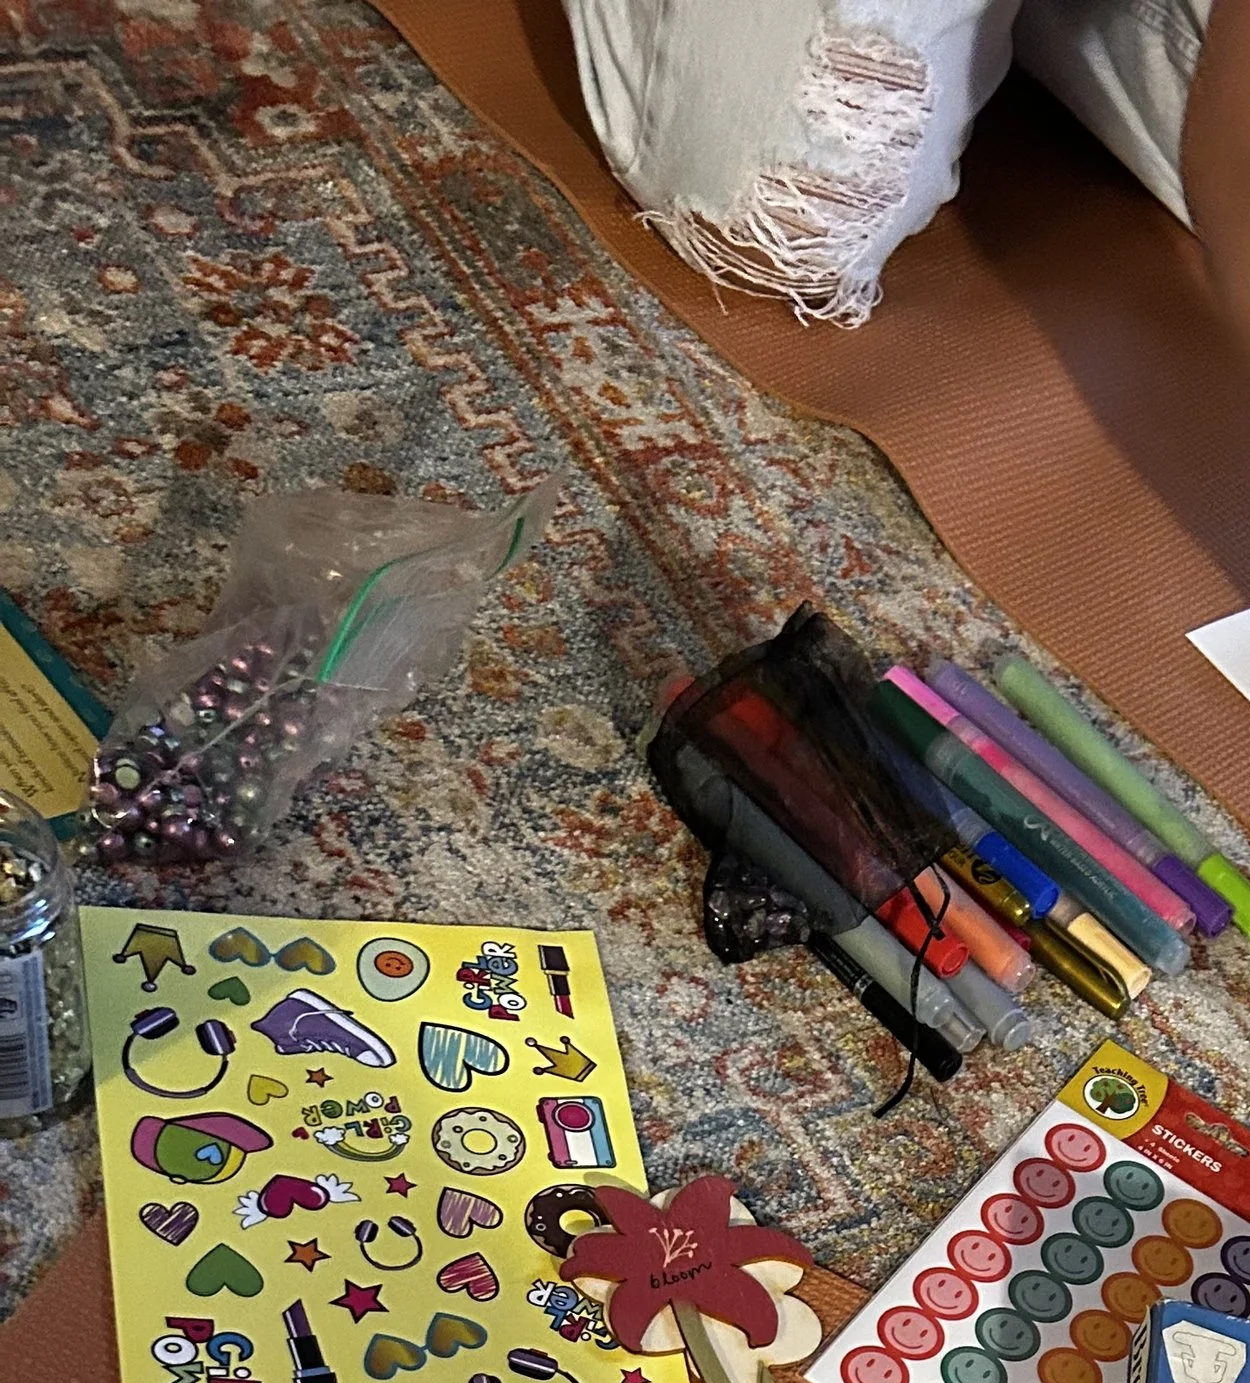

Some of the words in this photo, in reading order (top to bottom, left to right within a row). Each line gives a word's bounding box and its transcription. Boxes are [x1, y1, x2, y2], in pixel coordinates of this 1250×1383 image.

[1092, 1066, 1138, 1086] Teaching
[1137, 1084, 1149, 1107] Tree
[1152, 1124, 1223, 1173] STICKERS
[650, 1261, 712, 1289] bloom
